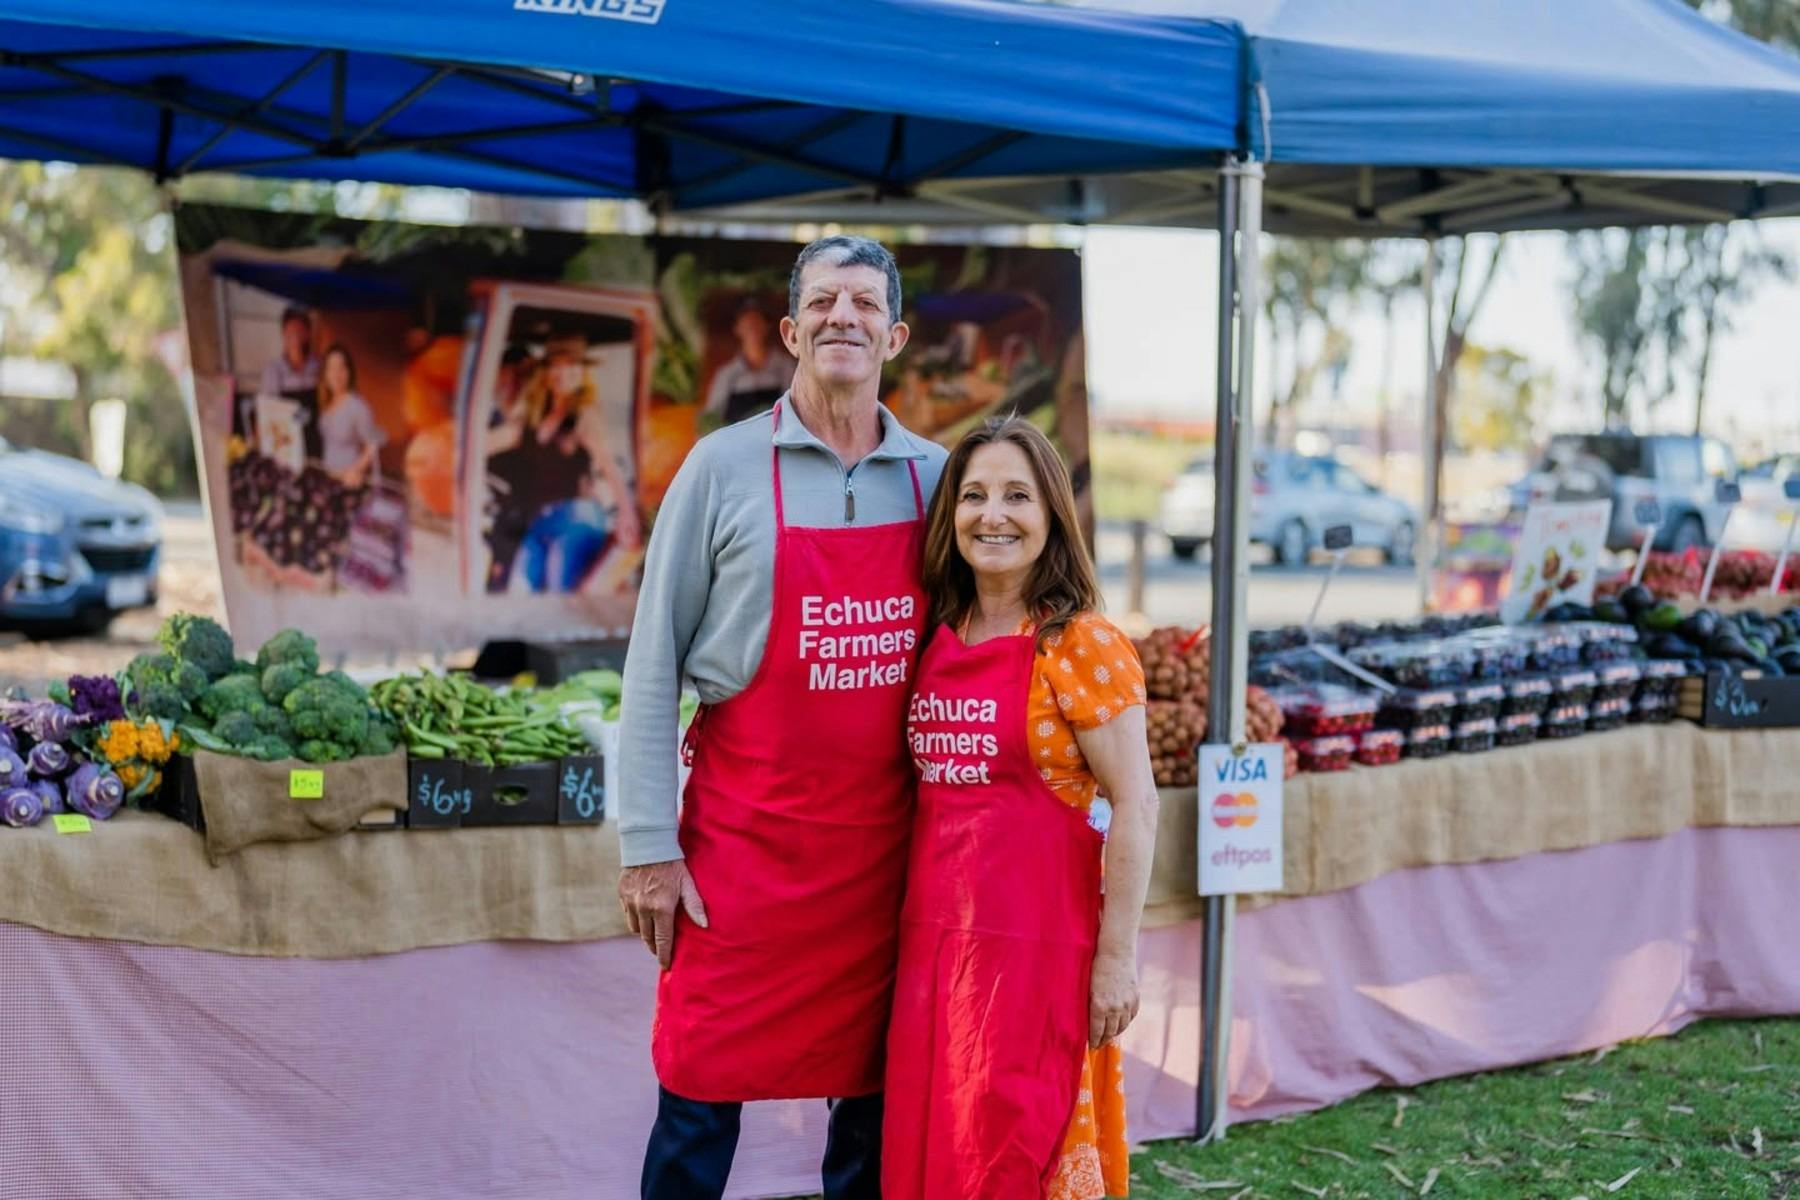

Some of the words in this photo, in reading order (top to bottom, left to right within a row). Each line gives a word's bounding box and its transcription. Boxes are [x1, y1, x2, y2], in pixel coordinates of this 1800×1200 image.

[802, 595, 915, 626] Echuca
[799, 628, 916, 659] Farmers
[808, 657, 908, 690] Market
[908, 692, 998, 722] Echuca
[907, 727, 999, 756] Farmers
[1215, 757, 1267, 782] VISA
[1211, 844, 1273, 870] eftpos
